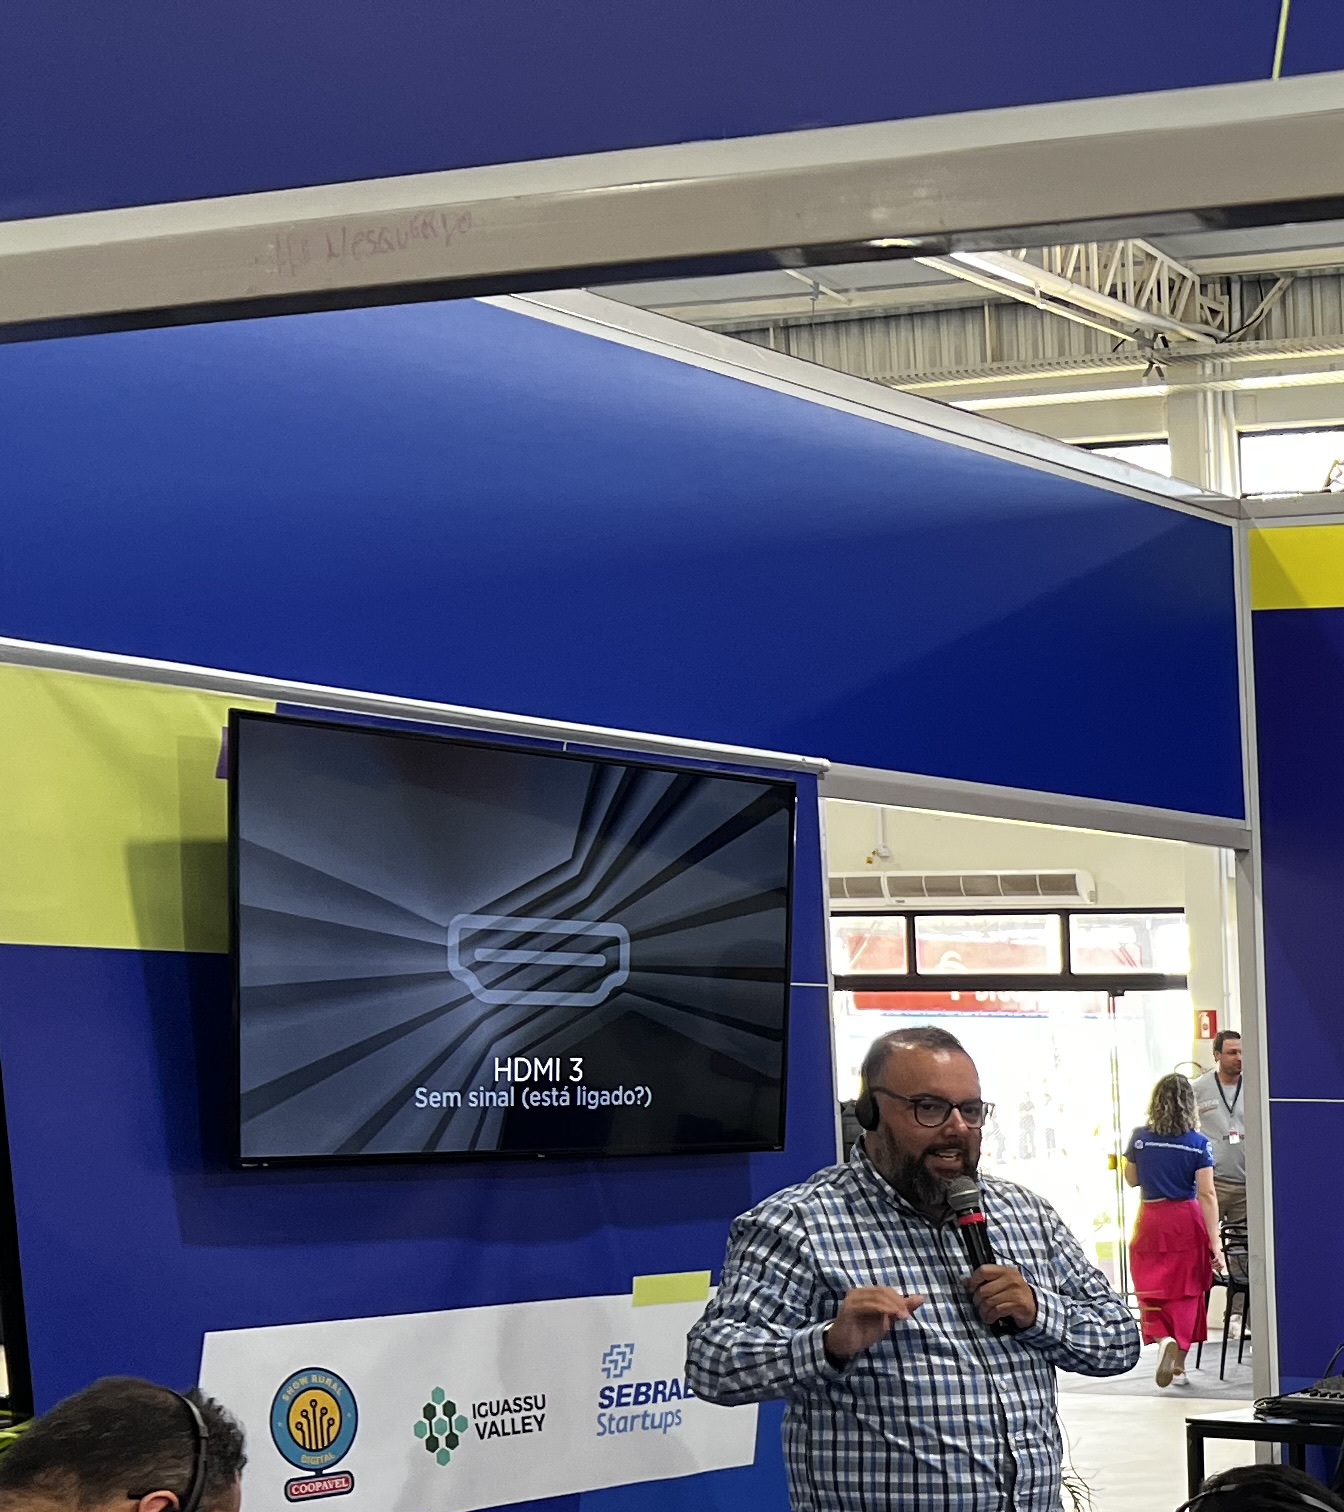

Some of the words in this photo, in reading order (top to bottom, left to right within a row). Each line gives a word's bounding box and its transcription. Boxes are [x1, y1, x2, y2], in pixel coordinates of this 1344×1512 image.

[494, 1057, 560, 1082] HDMI
[569, 1057, 584, 1082] 3
[415, 1087, 461, 1108] Sem
[468, 1086, 515, 1107] sinal
[521, 1085, 570, 1110] (está
[577, 1086, 652, 1110] ligado?)
[282, 1376, 308, 1401] SHOW
[311, 1374, 342, 1397] RURAL
[472, 1394, 546, 1419] IGUASSU
[475, 1414, 546, 1440] VALLEY
[597, 1409, 682, 1437] Startups
[291, 1478, 349, 1495] COOPAVEL
